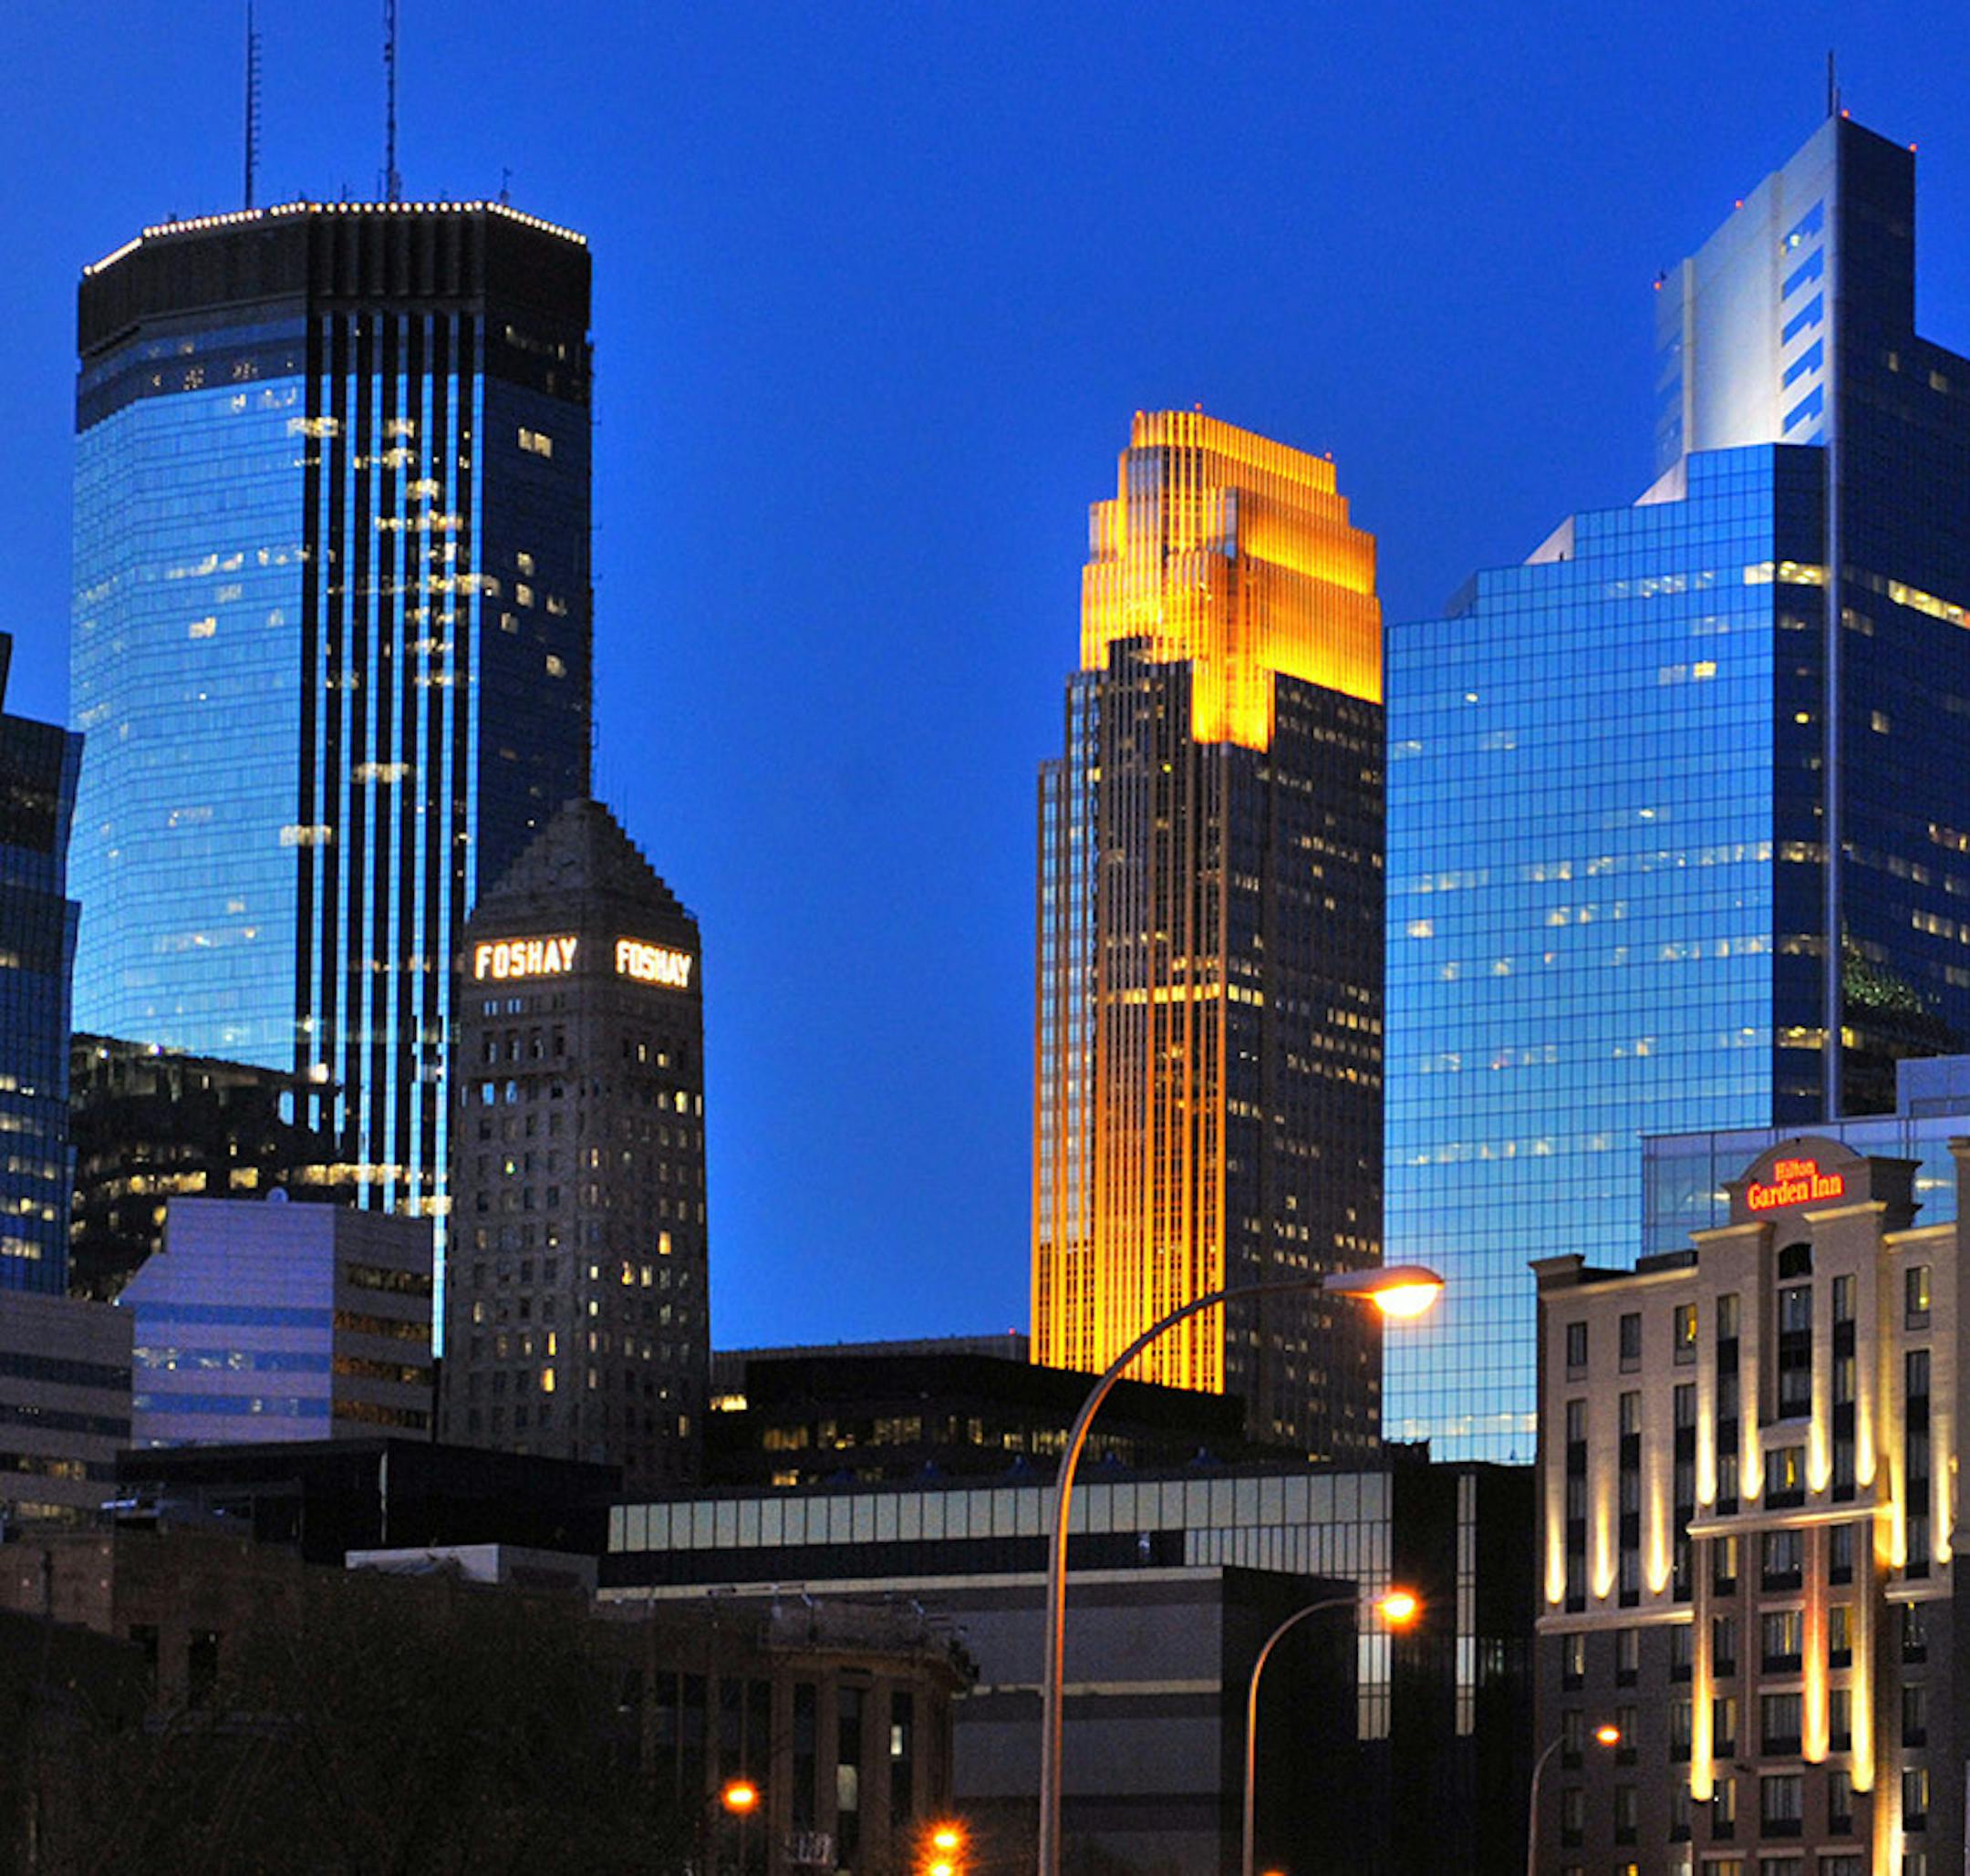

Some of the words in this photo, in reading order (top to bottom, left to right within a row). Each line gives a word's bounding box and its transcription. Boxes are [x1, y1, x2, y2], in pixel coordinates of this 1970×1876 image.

[474, 937, 577, 980] FOSHAY
[616, 939, 691, 988] FOSHAY
[1775, 1159, 1816, 1182] Hilton
[1747, 1181, 1809, 1210] Garden
[1810, 1174, 1842, 1197] Inn
